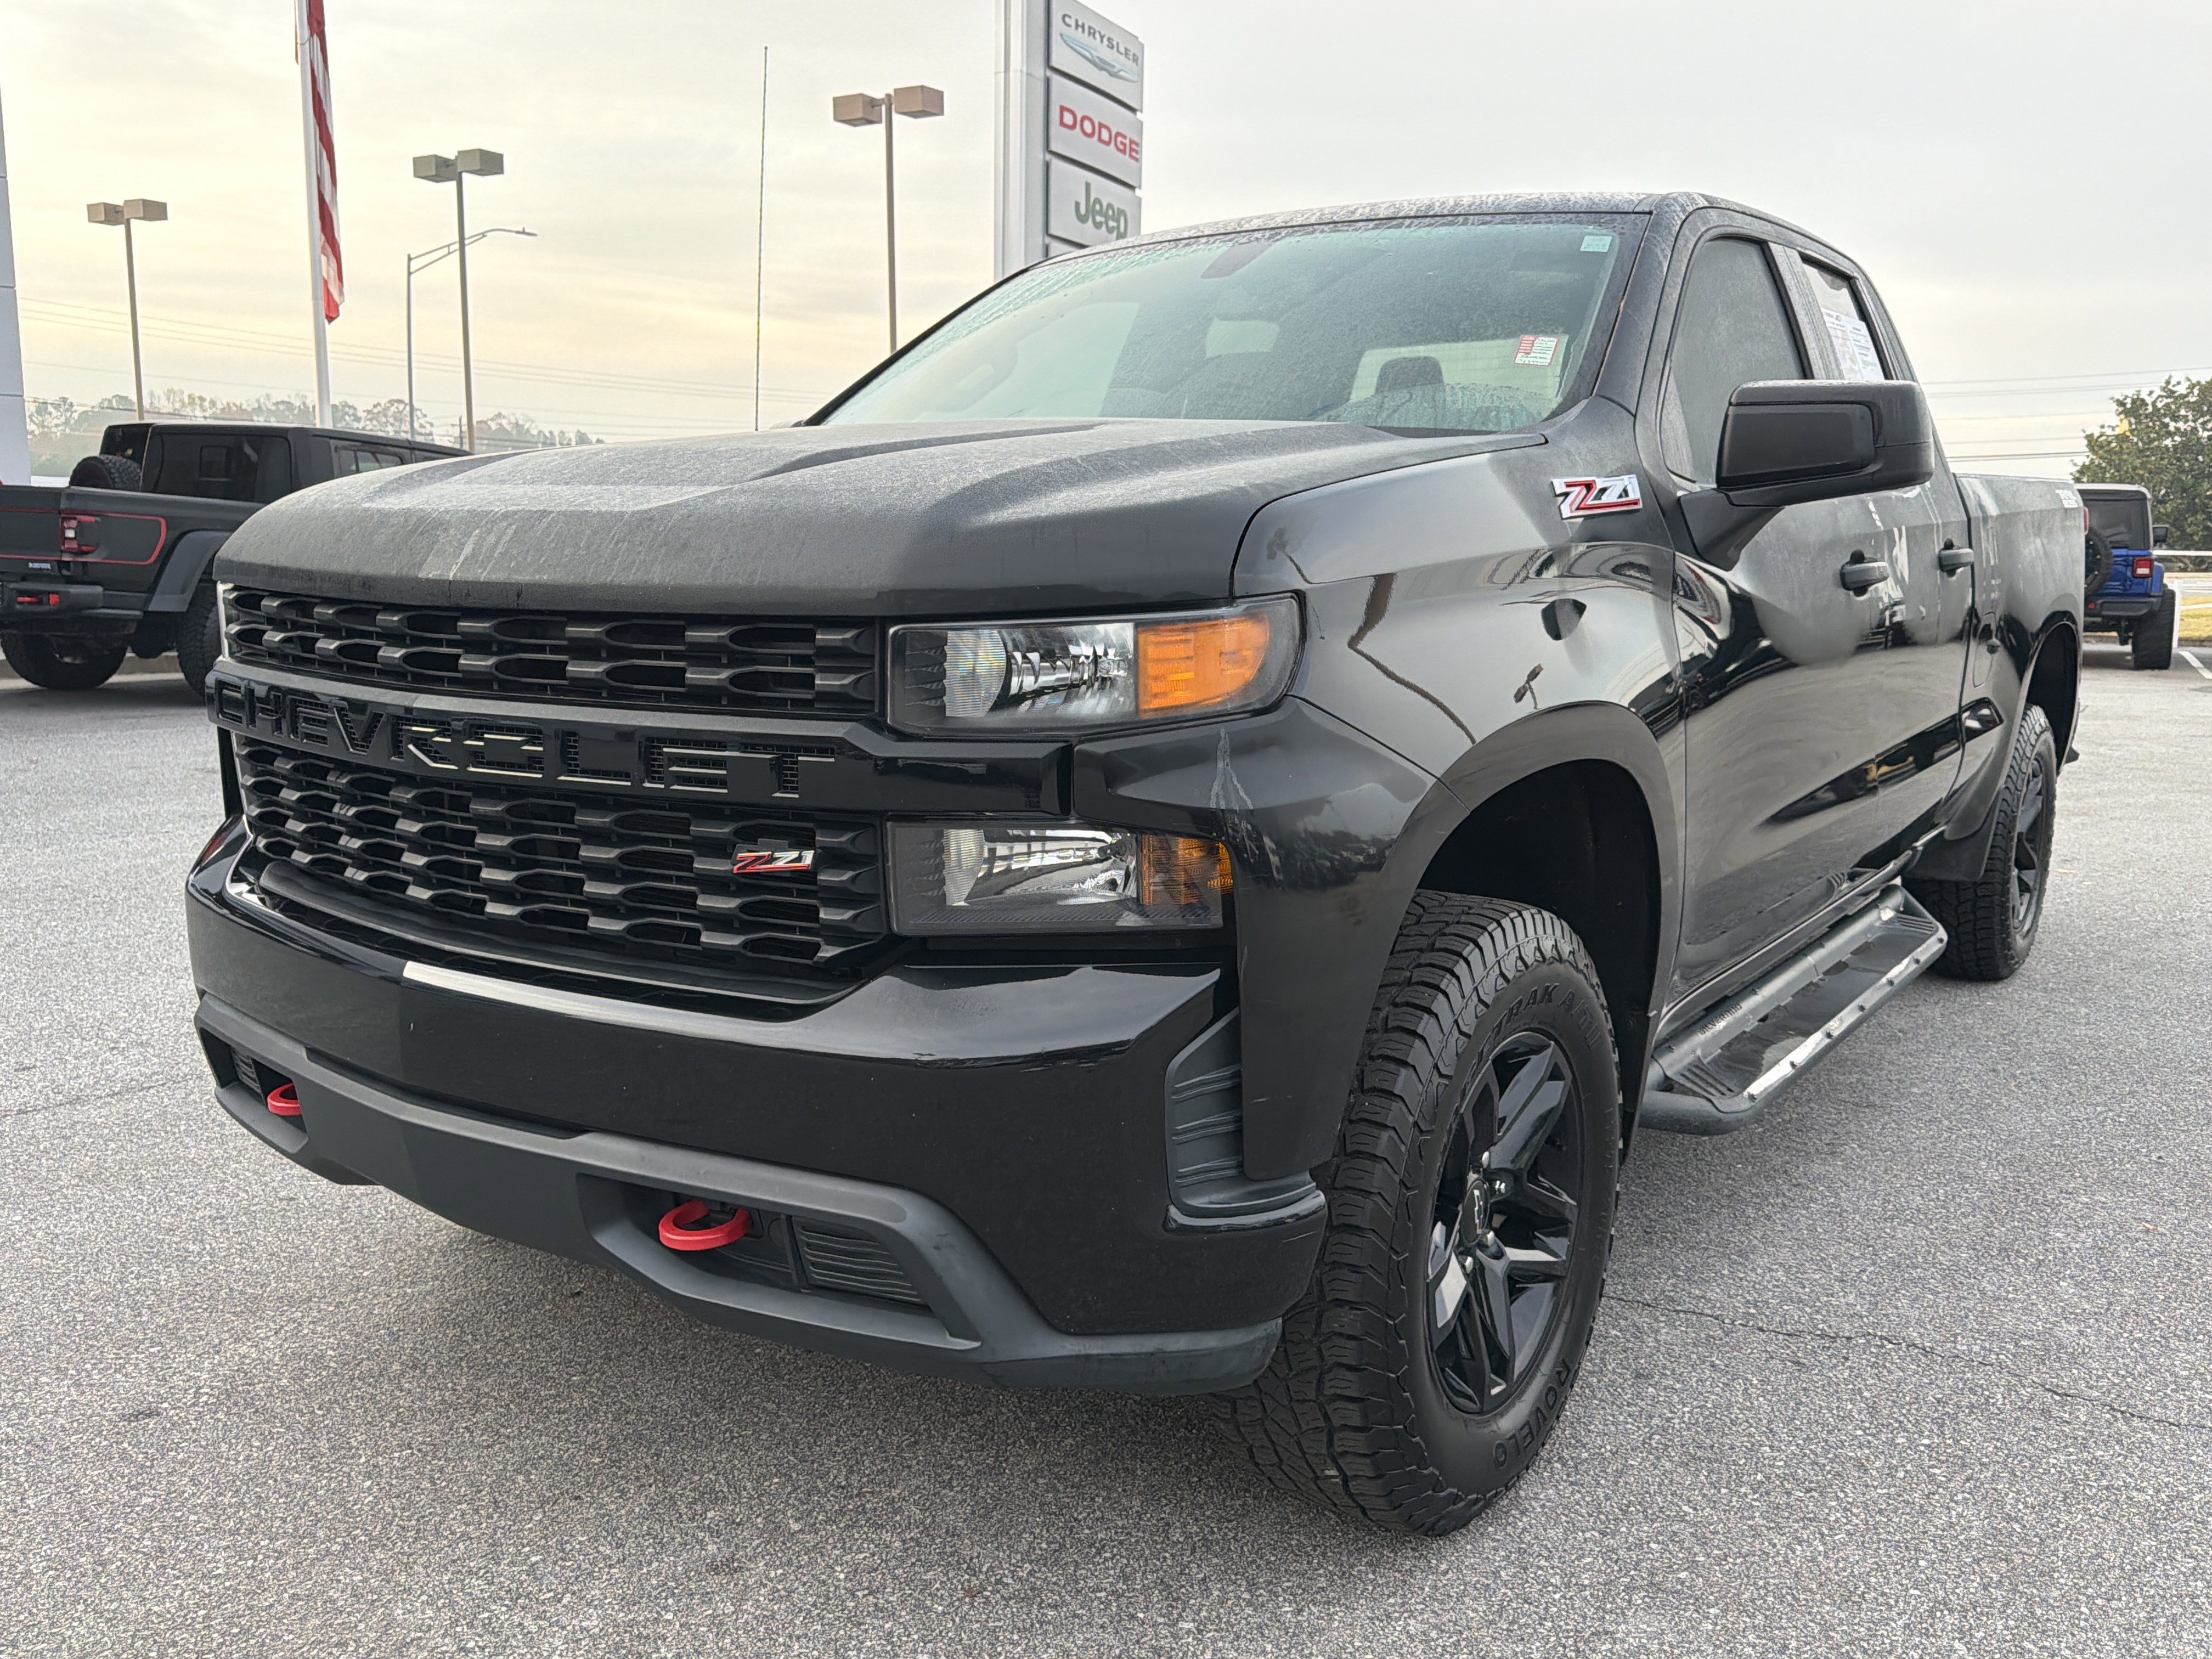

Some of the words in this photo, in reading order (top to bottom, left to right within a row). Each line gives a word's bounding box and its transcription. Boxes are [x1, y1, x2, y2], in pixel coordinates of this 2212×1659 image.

[1062, 13, 1139, 67] CHRYSLER
[1059, 104, 1140, 163] DODGE
[1074, 181, 1128, 240] Jeep
[215, 676, 836, 799] CHEVROLET
[1493, 1358, 1571, 1470] ROVELO
